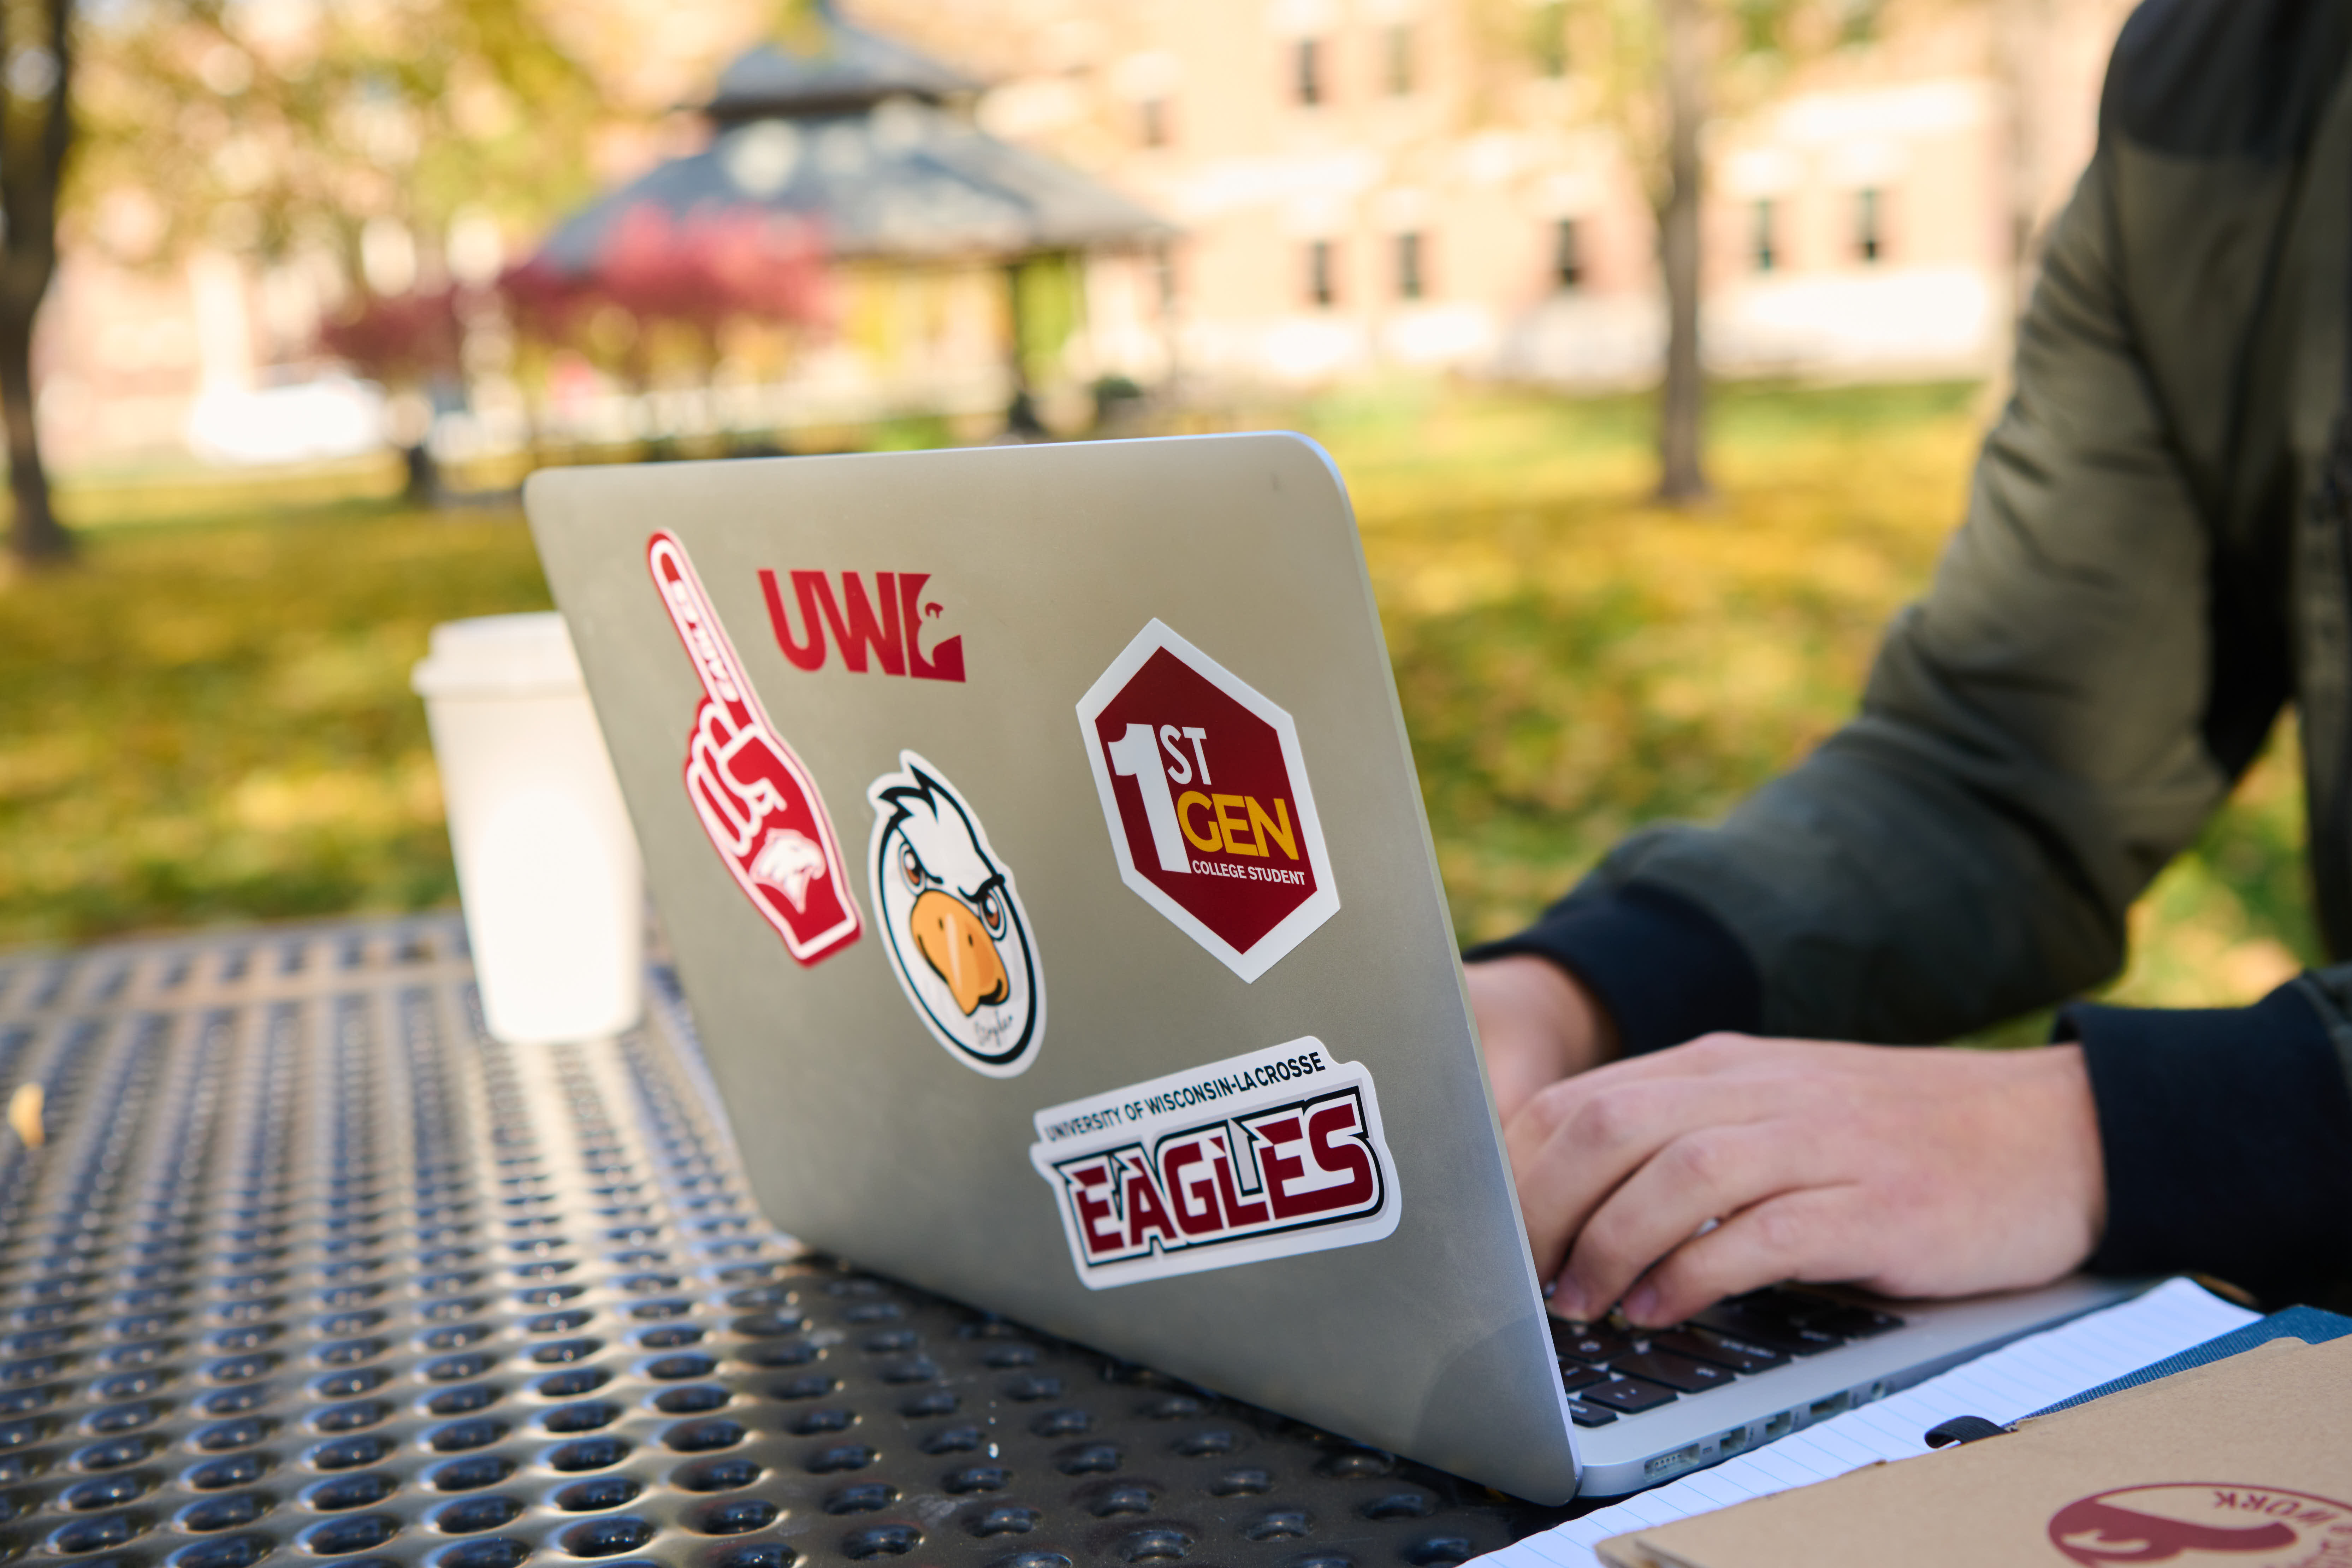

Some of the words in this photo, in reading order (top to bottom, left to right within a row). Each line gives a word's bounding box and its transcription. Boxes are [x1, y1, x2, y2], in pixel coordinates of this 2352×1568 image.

[1177, 791, 1299, 860] GEN
[1192, 860, 1247, 879] COLLEGE
[1248, 866, 1305, 885] STUDENT
[1044, 1107, 1122, 1142] UNIVERSITY
[1124, 1101, 1143, 1121] OF
[1072, 1103, 1373, 1254] EAGLES
